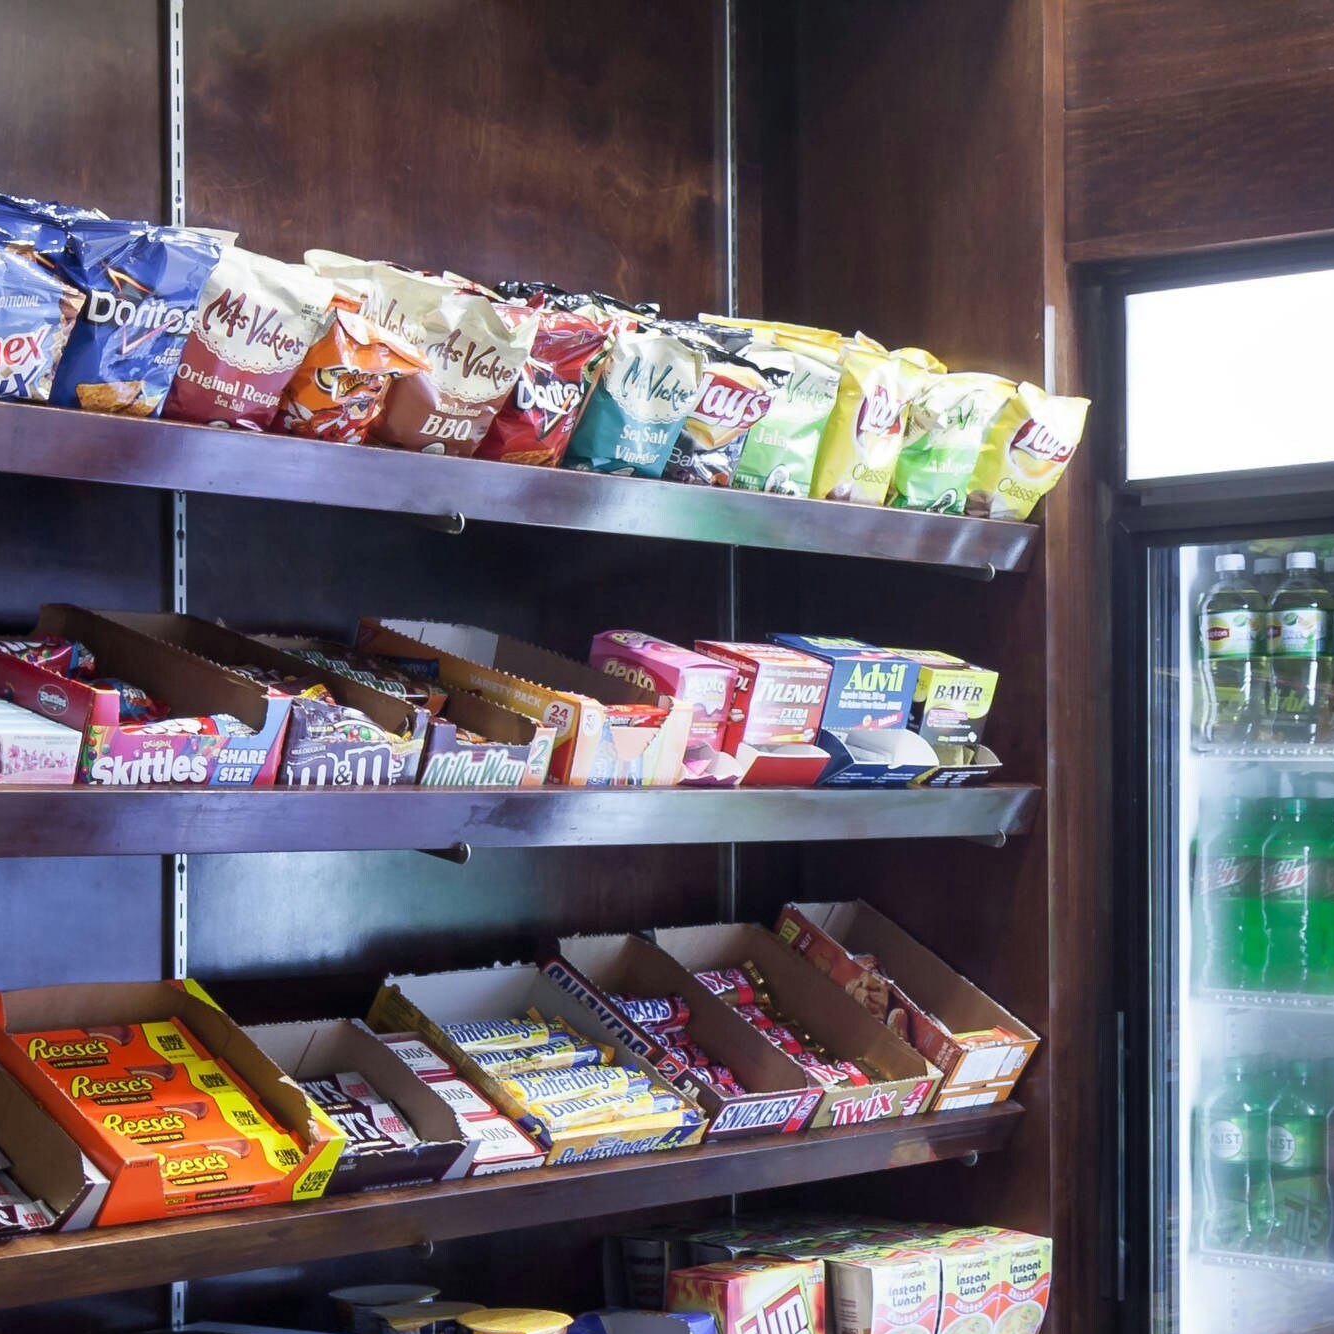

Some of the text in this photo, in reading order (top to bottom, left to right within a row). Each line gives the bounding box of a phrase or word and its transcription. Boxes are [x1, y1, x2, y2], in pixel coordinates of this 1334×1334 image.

[87, 288, 199, 334] Doritos
[245, 304, 305, 360] Vickie's
[177, 362, 240, 398] Original
[214, 394, 246, 413] Sea Salt
[686, 370, 772, 430] Lay's
[419, 414, 473, 440] BBQ
[620, 424, 641, 442] Sea
[844, 662, 908, 692] Advil
[470, 675, 541, 708] VARIETY PACK
[934, 685, 982, 701] BAYER
[549, 704, 569, 719] 24
[780, 708, 808, 719] EXTRA
[218, 749, 267, 765] SHARE
[530, 739, 550, 765] 2
[90, 750, 208, 784] Skittles
[219, 766, 253, 783] SIZE
[421, 749, 527, 785] Milky Way
[28, 1038, 109, 1061] Reese's
[70, 1075, 154, 1098] Reese's
[521, 1067, 622, 1099] Butterfinger
[680, 1080, 701, 1098] 24
[231, 1110, 255, 1119] KING
[236, 1117, 261, 1126] SIZE
[717, 1098, 798, 1130] SNICKERS
[103, 1113, 186, 1136] Reese's
[274, 1148, 298, 1158] KING
[303, 1169, 332, 1183] KING
[296, 1181, 325, 1194] SIZE
[1010, 1260, 1042, 1275] Instant
[956, 1271, 991, 1286] Instant
[1013, 1272, 1038, 1284] Lunch
[889, 1282, 927, 1297] Instant
[959, 1284, 987, 1297] Lunch
[892, 1295, 922, 1307] Lunch
